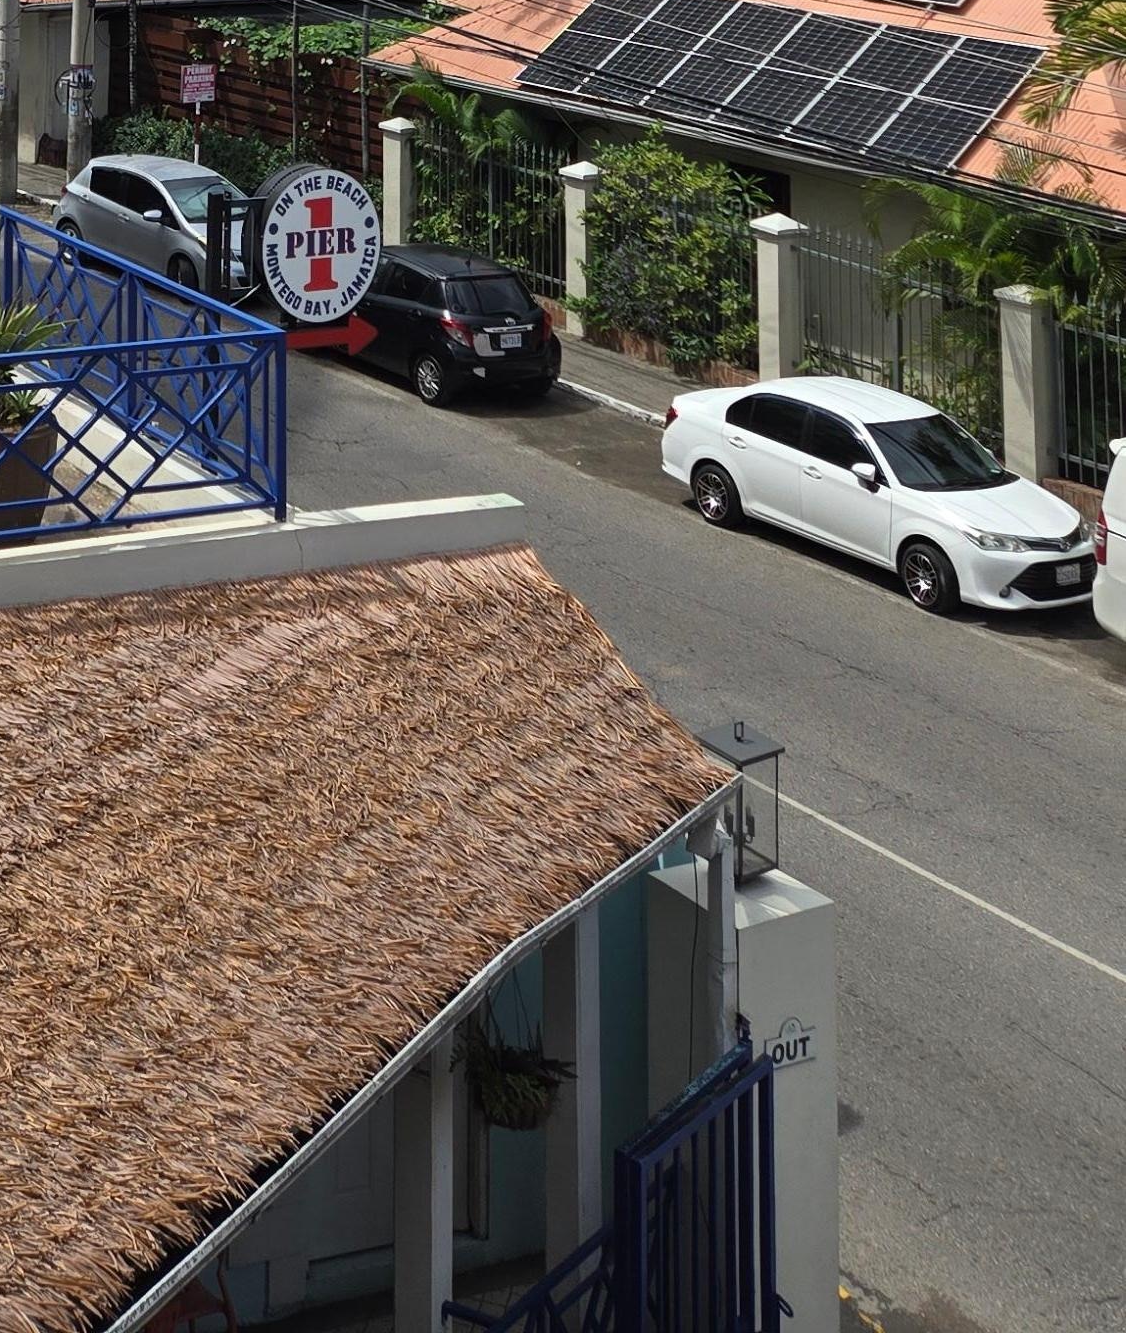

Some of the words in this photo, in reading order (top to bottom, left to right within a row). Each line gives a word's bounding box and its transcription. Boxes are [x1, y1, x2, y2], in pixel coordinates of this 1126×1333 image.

[275, 193, 294, 217] ON
[294, 175, 322, 197] THE
[326, 175, 369, 210] BEACH
[285, 227, 357, 259] PIER
[266, 243, 302, 311] MONTEGO
[304, 299, 337, 316] BAY,
[340, 235, 377, 307] JAMAICA
[771, 1035, 810, 1065] OUT
